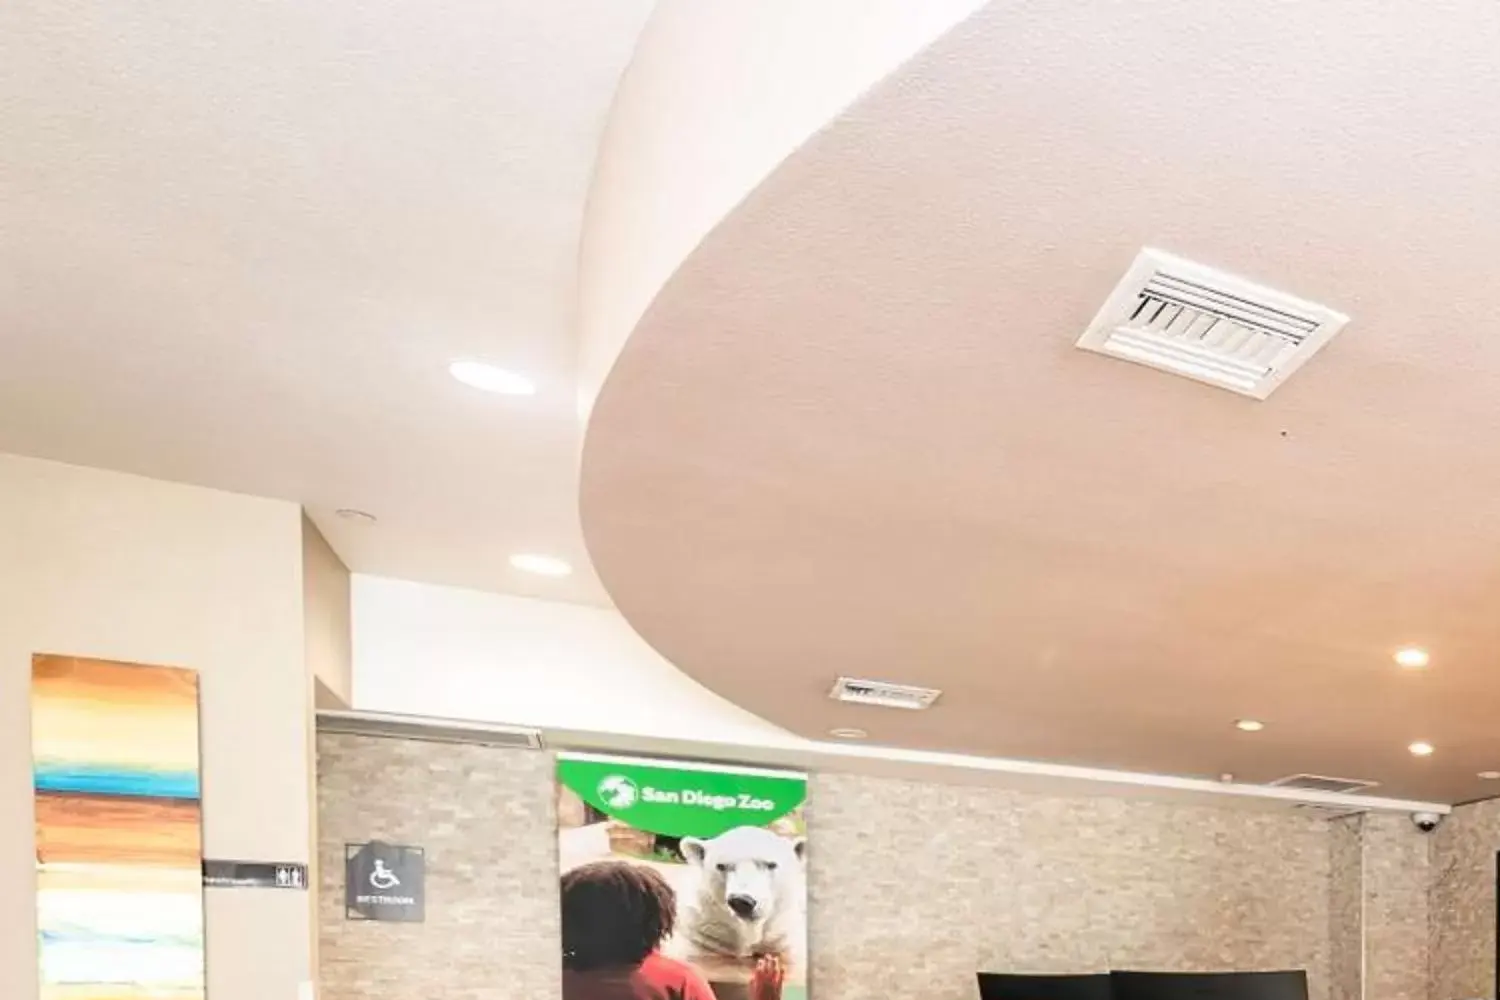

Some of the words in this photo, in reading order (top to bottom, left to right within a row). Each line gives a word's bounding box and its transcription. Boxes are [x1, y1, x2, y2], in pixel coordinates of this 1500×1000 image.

[641, 786, 679, 804] San
[682, 789, 735, 811] Diego
[738, 793, 775, 811] Zoo
